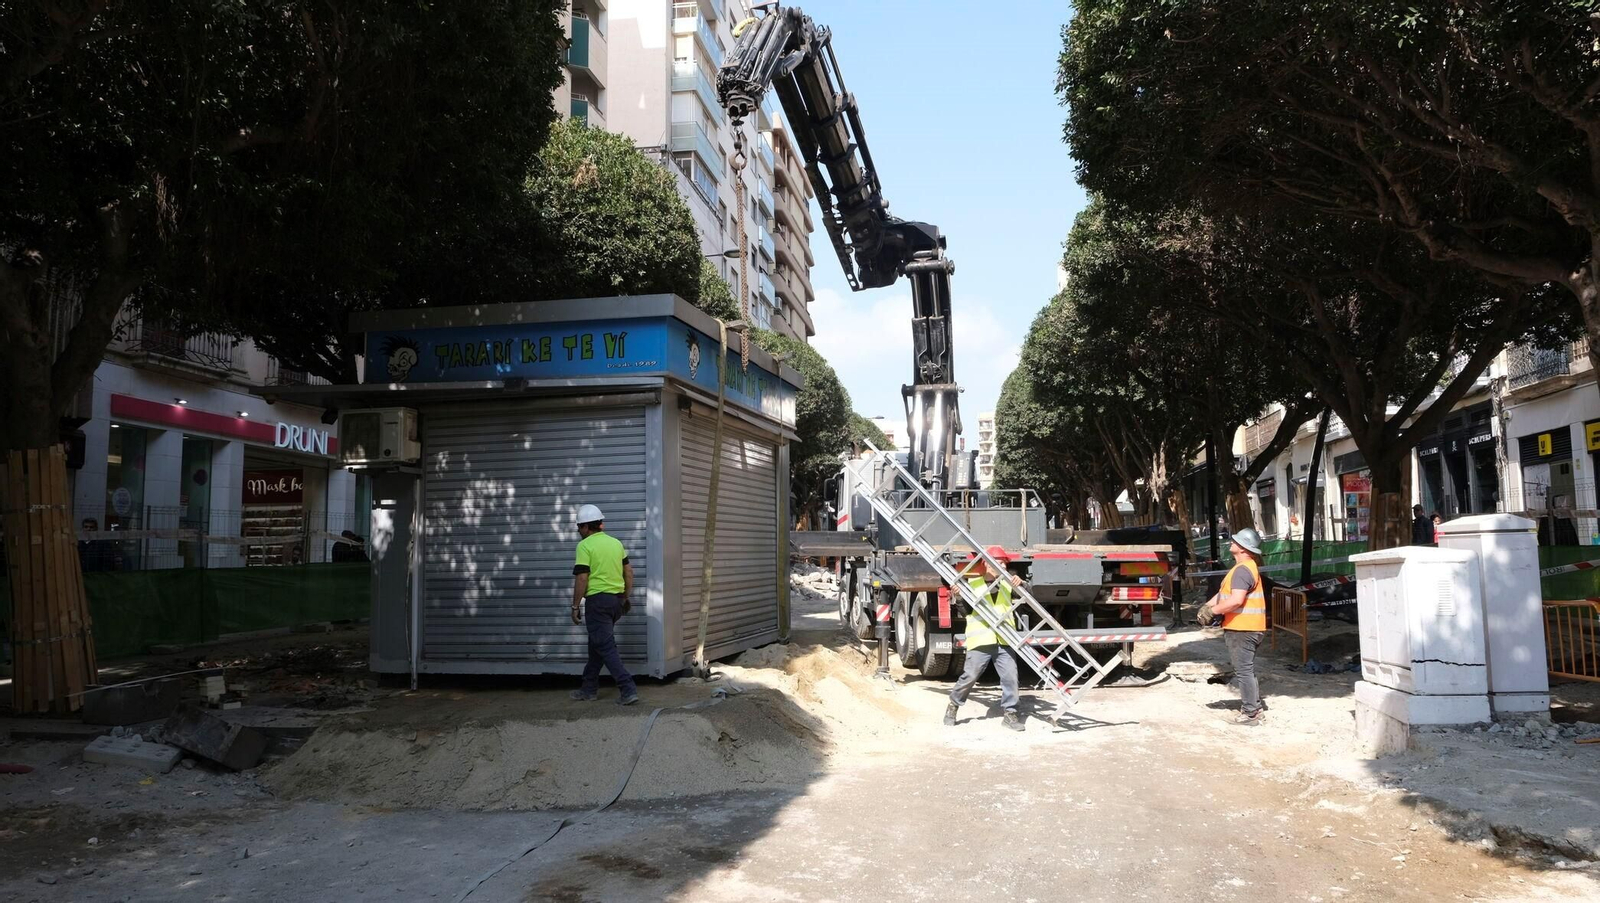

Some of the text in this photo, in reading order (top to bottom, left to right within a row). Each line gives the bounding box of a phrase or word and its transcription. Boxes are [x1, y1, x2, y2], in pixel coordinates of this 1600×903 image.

[435, 331, 627, 369] TARARÍ KE TE VÍ
[275, 421, 329, 455] DRUNI
[247, 478, 290, 495] Mask
